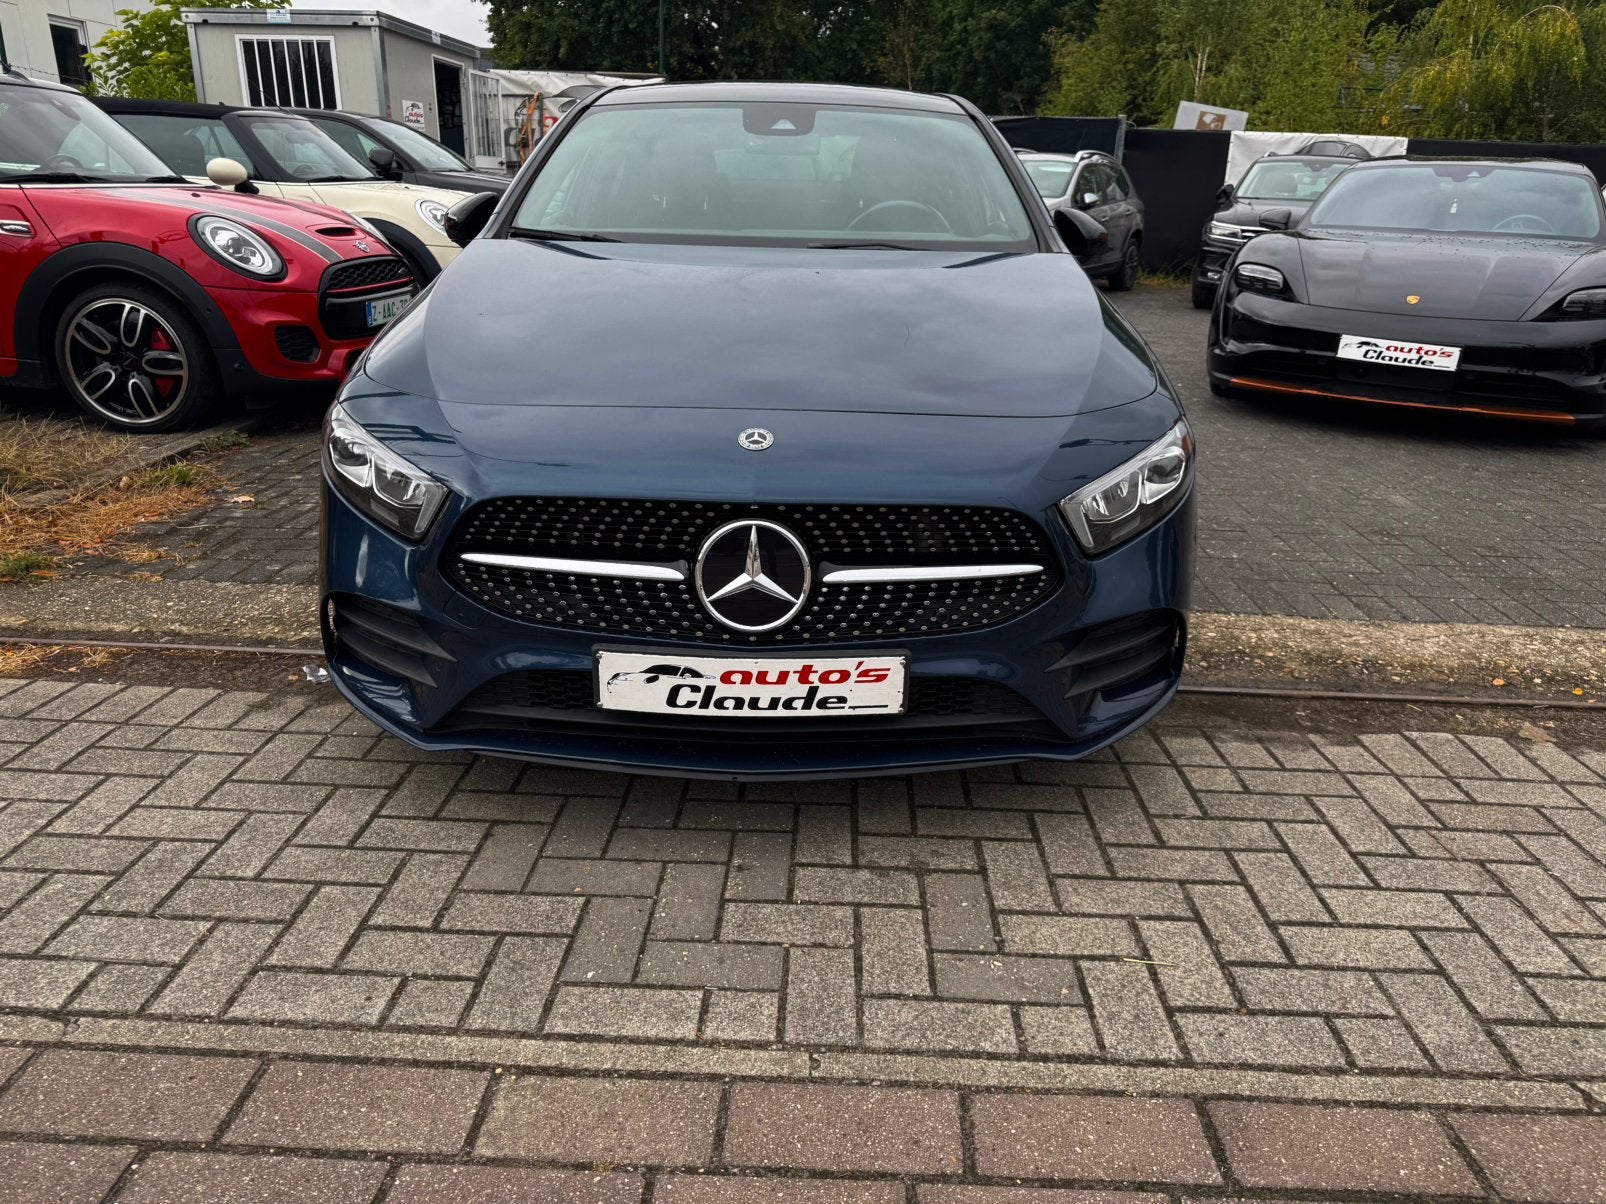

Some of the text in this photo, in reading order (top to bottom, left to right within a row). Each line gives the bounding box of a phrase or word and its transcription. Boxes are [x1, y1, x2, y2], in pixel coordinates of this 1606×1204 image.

[1362, 349, 1434, 366] Claude
[1385, 345, 1454, 358] auto's
[719, 661, 891, 685] auto's
[666, 684, 848, 711] Claude
